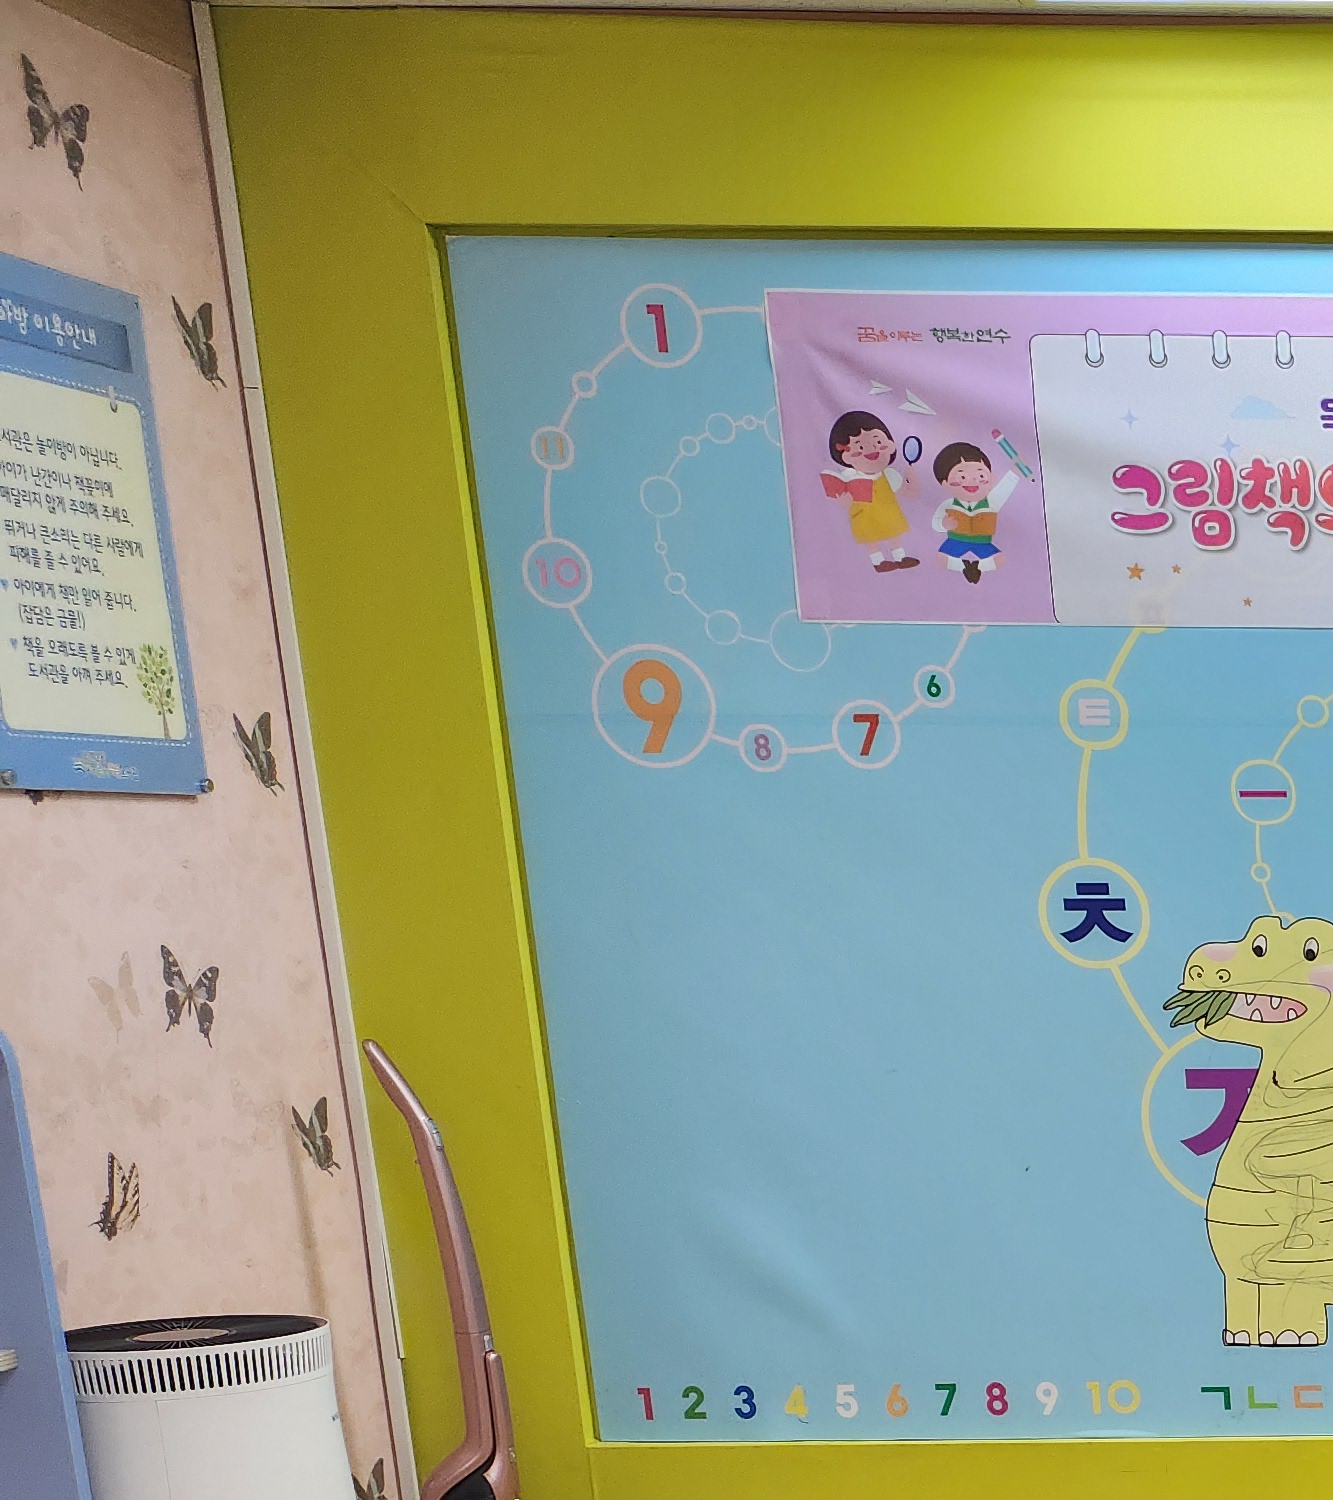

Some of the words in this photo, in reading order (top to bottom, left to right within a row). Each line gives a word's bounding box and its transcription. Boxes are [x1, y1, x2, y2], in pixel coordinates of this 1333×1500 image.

[33, 313, 97, 350] 이용안내
[646, 304, 669, 353] 1
[0, 428, 33, 453] 서관은
[36, 434, 77, 461] 놀이방이
[80, 445, 122, 471] 아닙니다.
[540, 437, 565, 459] 11
[30, 466, 72, 490] 난간이나
[69, 498, 99, 519] 주의해
[101, 505, 134, 528] 주세요.
[82, 532, 104, 554] 다른
[106, 537, 144, 558] 사람에게
[58, 552, 69, 570] 수
[71, 554, 104, 576] 있어요.
[535, 557, 582, 588] 10
[14, 578, 56, 600] 아이에게
[58, 583, 80, 606] 책만
[22, 636, 45, 657] 책을
[48, 640, 89, 663] 오래도록
[90, 644, 101, 663] 볼
[104, 646, 114, 663] 수
[116, 647, 137, 666] 있게
[28, 662, 69, 685] 도서관을
[95, 669, 129, 688] 주세요.
[926, 674, 942, 697] 6
[623, 659, 682, 753] 9
[754, 733, 772, 761] 8
[853, 714, 879, 756] 7
[1060, 882, 1133, 944] ㅊ
[637, 1387, 655, 1420] 1
[682, 1386, 707, 1419] 2
[733, 1385, 757, 1419] 3
[784, 1385, 808, 1418] 4
[835, 1384, 859, 1418] 5
[885, 1383, 909, 1417] 6
[935, 1383, 957, 1416] 7
[985, 1382, 1009, 1416] 8
[1035, 1381, 1059, 1416] 9
[1086, 1380, 1141, 1415] 10
